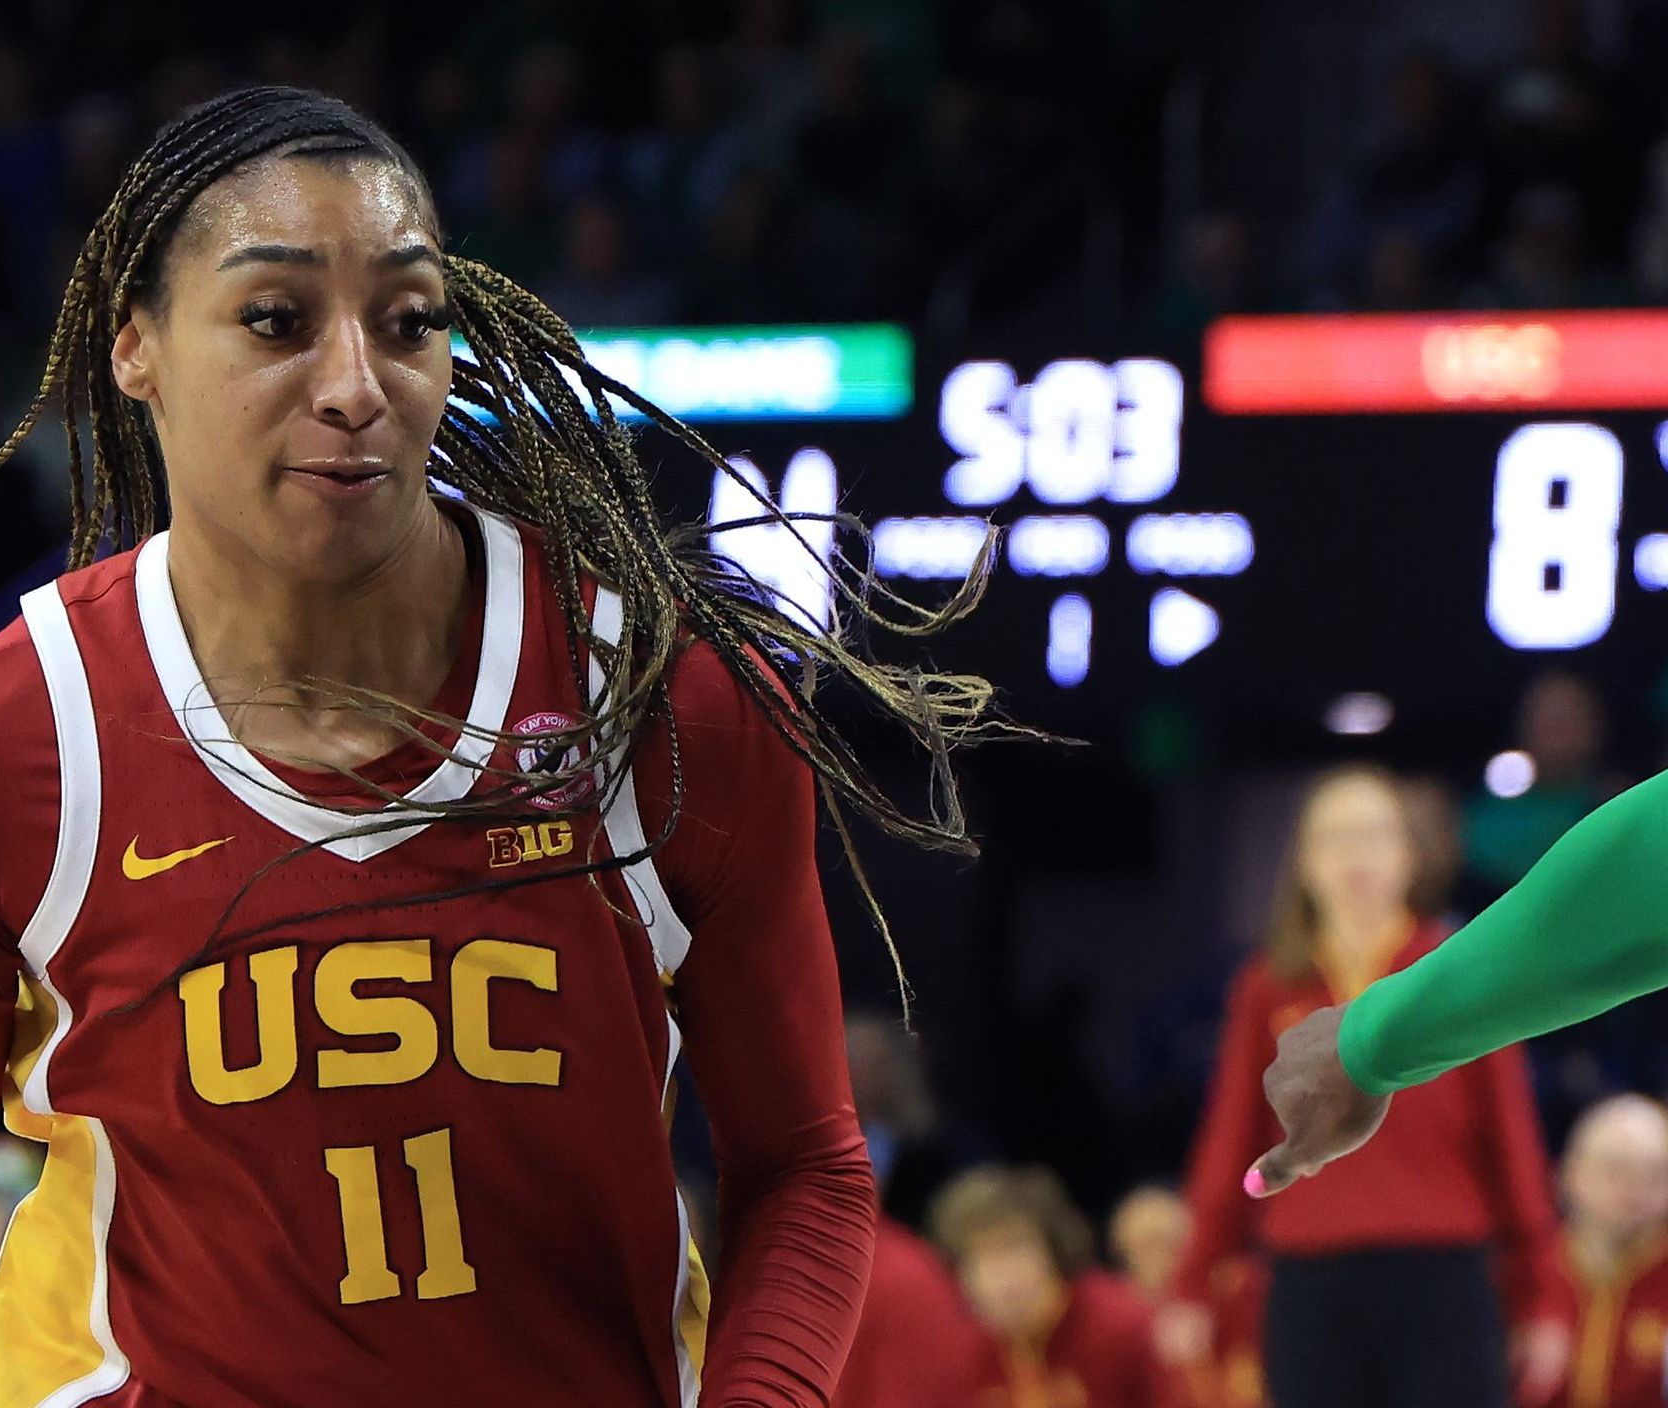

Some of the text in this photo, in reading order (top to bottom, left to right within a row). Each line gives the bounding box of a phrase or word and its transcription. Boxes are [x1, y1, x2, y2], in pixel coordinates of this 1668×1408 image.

[1486, 423, 1624, 653] 8
[519, 716, 541, 735] KAY
[180, 939, 563, 1106] USC
[324, 1128, 478, 1305] 11
